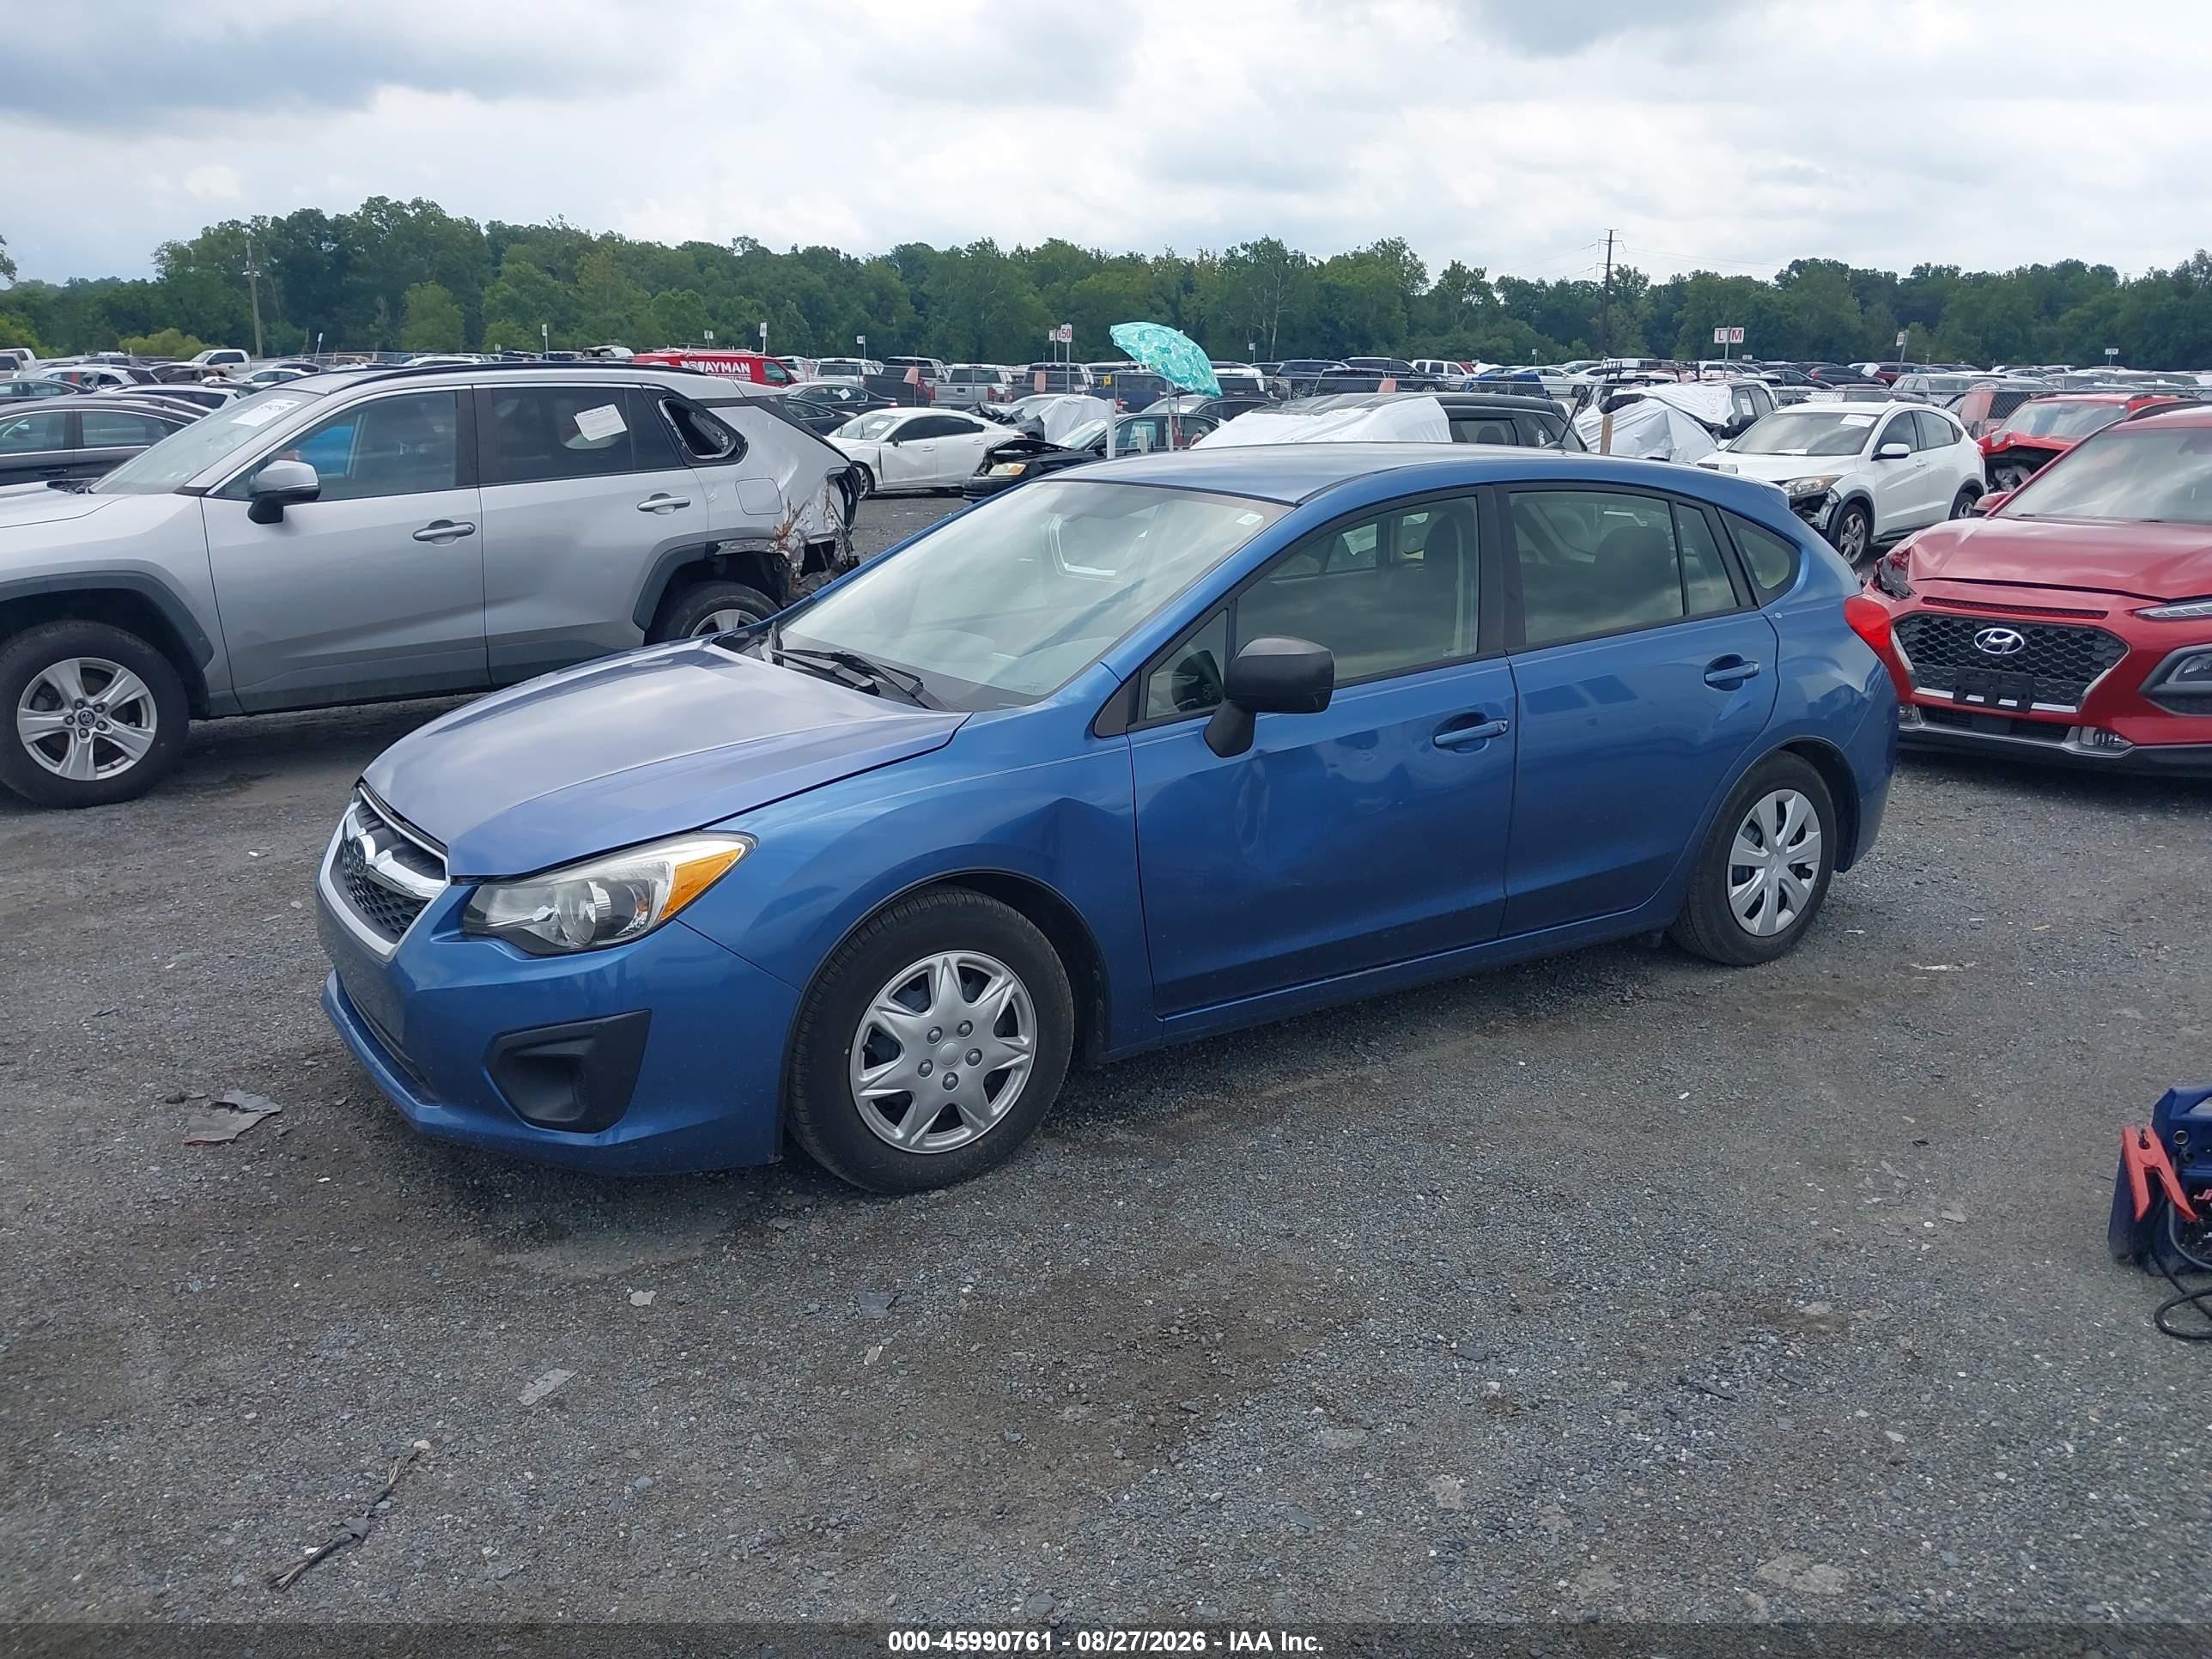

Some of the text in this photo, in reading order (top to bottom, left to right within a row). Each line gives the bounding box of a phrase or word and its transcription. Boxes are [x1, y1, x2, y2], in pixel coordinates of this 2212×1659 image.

[1061, 328, 1071, 338] 50
[1718, 330, 1742, 340] L M
